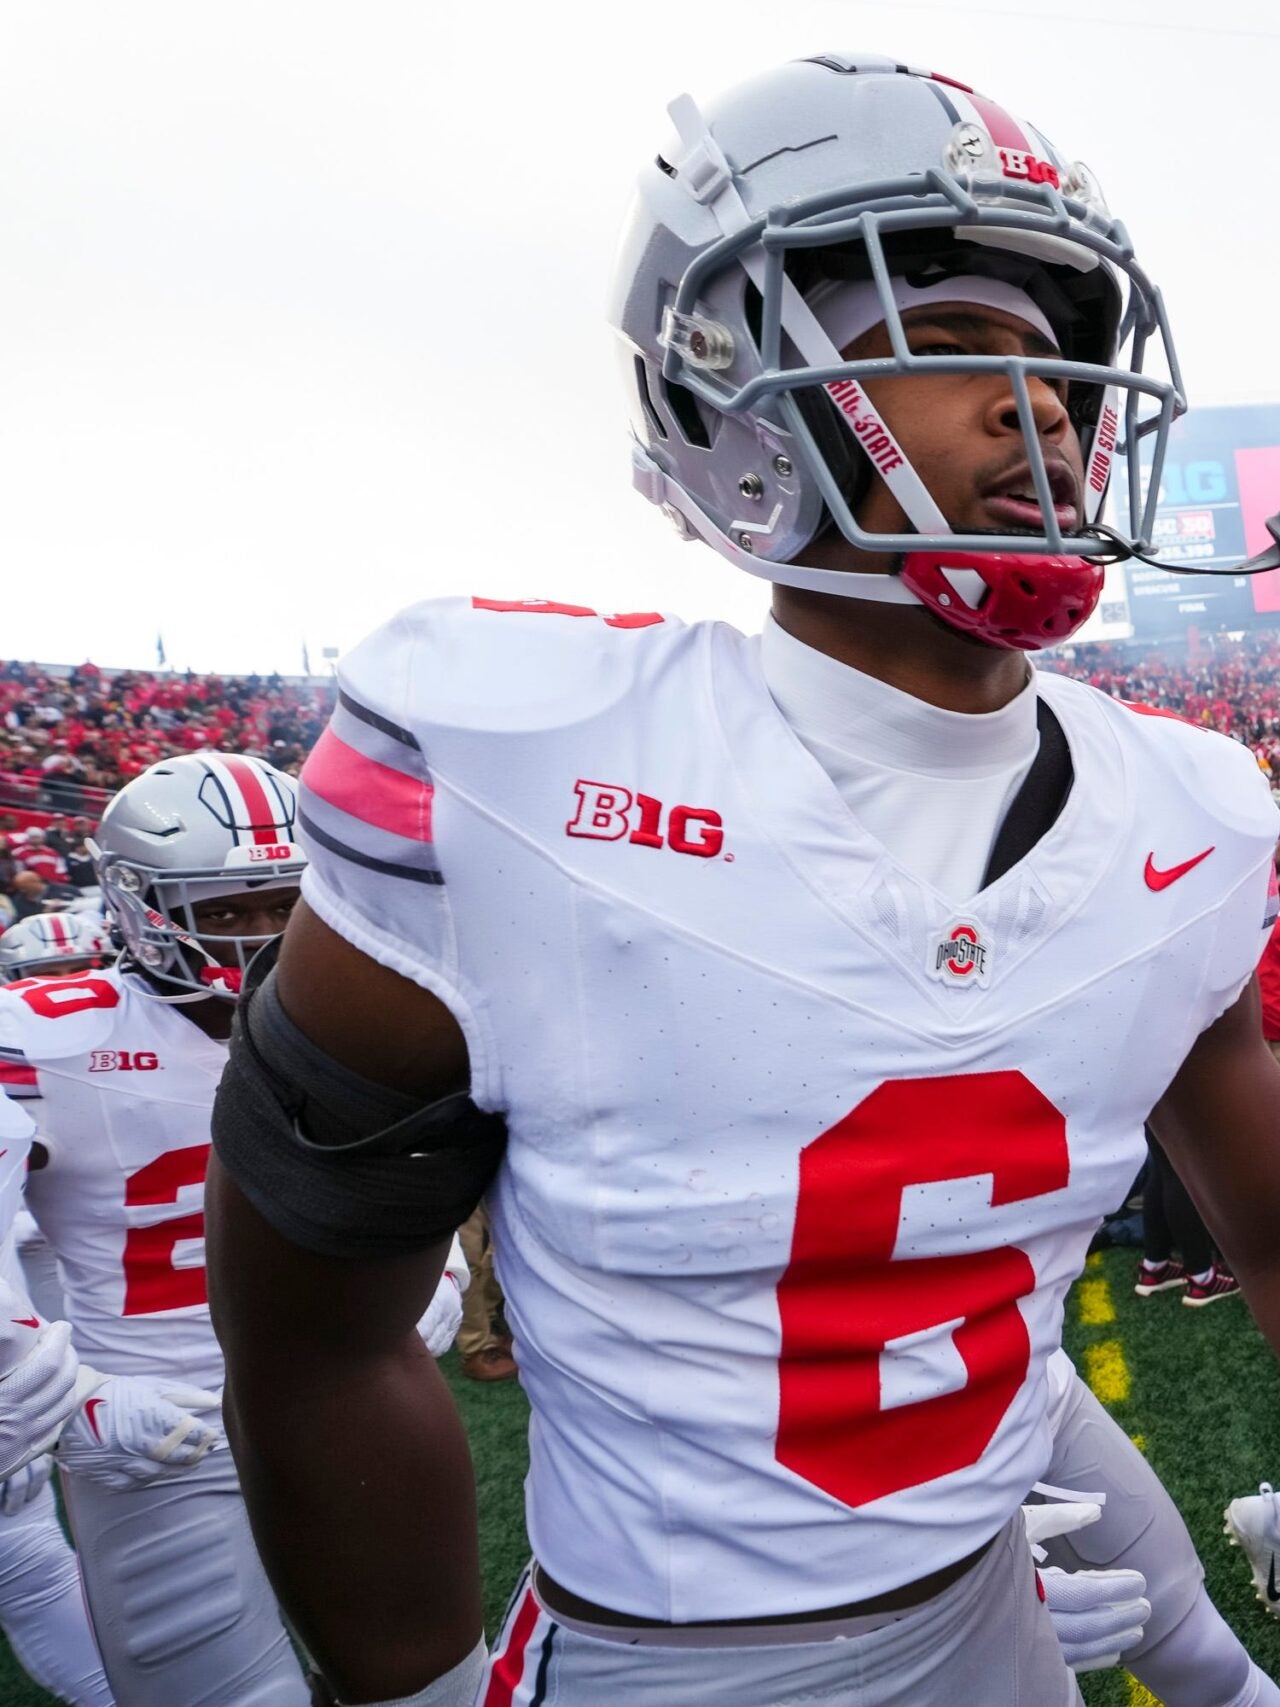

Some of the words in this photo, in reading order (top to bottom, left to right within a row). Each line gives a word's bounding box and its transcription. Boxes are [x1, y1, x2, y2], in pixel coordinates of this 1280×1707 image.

[826, 380, 862, 417] HIO
[854, 414, 904, 475] STATE
[1097, 404, 1118, 452] STATE
[1089, 451, 1111, 493] OHIO
[775, 1069, 1070, 1509] 6
